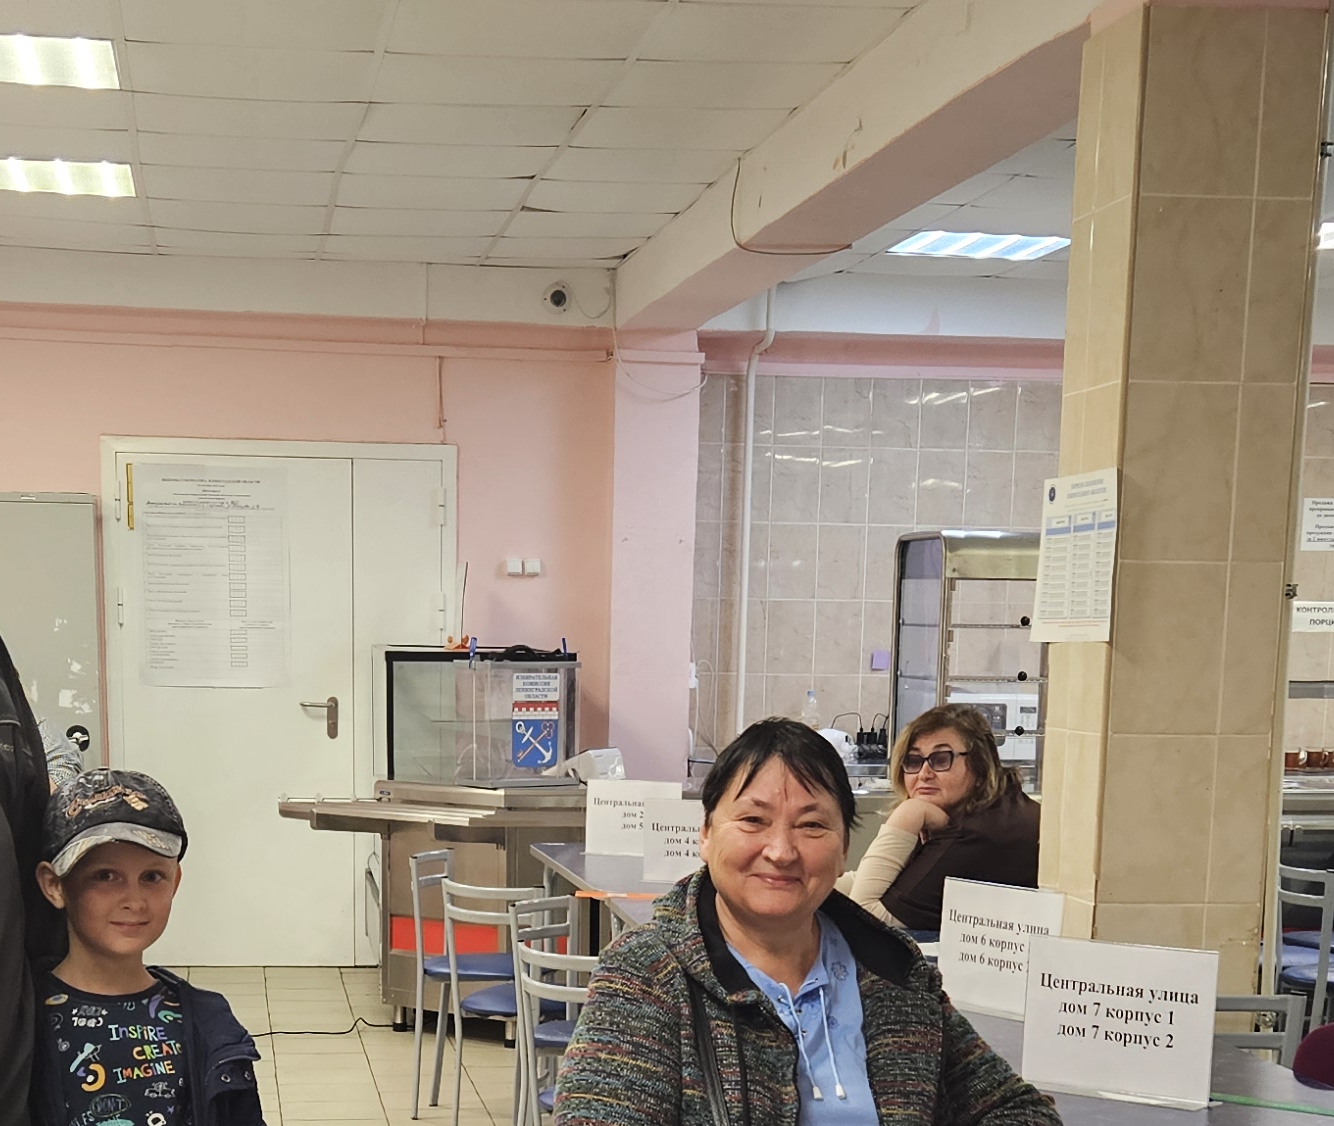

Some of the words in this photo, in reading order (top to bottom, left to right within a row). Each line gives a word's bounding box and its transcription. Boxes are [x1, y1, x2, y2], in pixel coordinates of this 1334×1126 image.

[593, 797, 644, 808] Центральна
[639, 811, 644, 819] 2
[639, 822, 644, 830] 5
[651, 822, 700, 834] Централь
[664, 837, 682, 845] дом
[684, 836, 690, 845] 4
[664, 849, 682, 858] дом
[684, 848, 690, 858] 4
[949, 908, 1015, 932] Центральная
[1017, 922, 1050, 936] улица
[959, 932, 978, 945] дом
[980, 933, 987, 946] 6
[988, 938, 1025, 953] корпус
[958, 950, 977, 964] дом
[979, 951, 985, 966] 6
[987, 957, 1023, 973] корпус
[1040, 972, 1144, 999] Центральная
[1148, 987, 1199, 1005] улица
[1058, 1001, 1087, 1016] дом
[1093, 1002, 1101, 1017] 7
[1105, 1007, 1162, 1027] корпус
[1167, 1010, 1174, 1025] 1
[1057, 1022, 1086, 1038] дом
[1092, 1024, 1100, 1040] 7
[1104, 1029, 1160, 1050] корпус
[1165, 1033, 1174, 1049] 2
